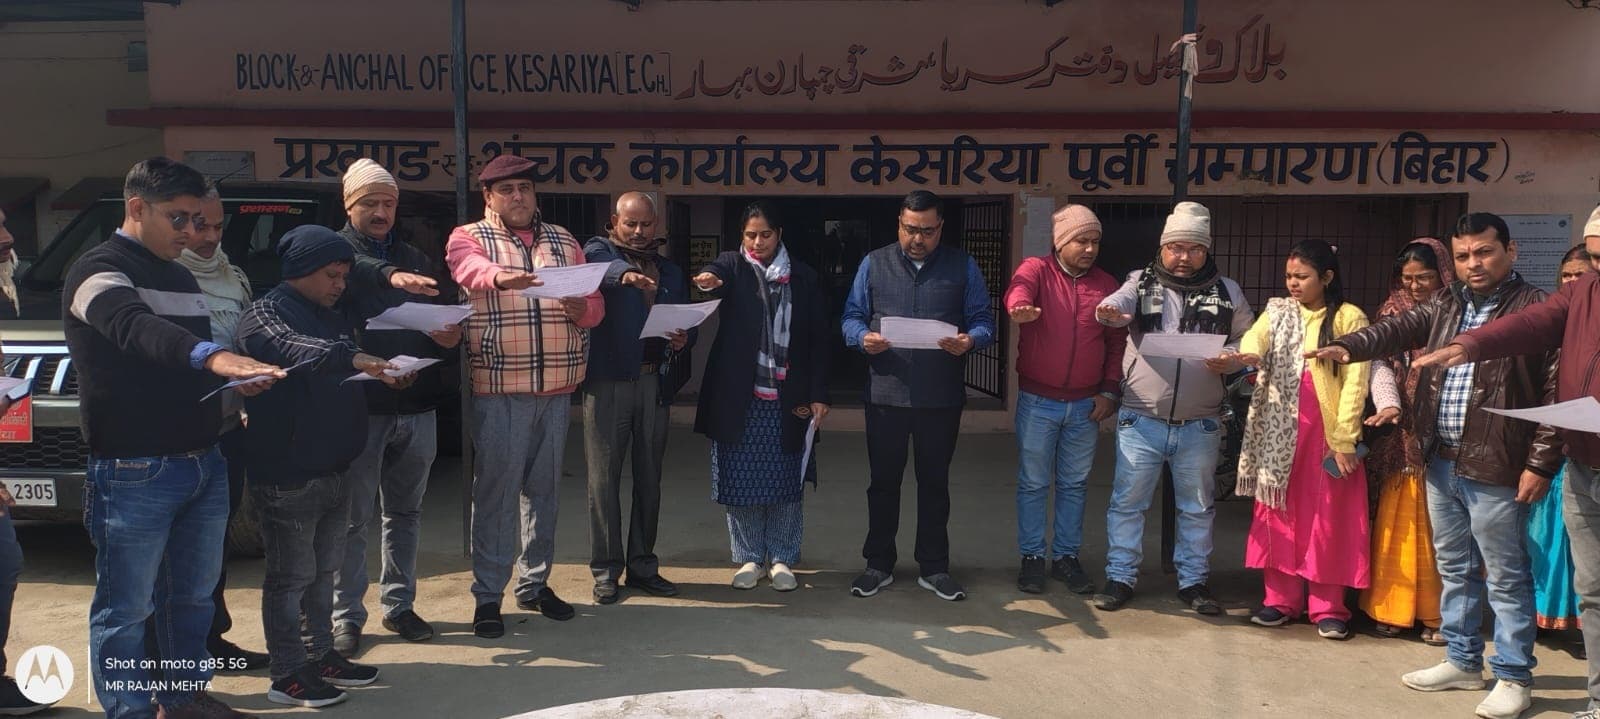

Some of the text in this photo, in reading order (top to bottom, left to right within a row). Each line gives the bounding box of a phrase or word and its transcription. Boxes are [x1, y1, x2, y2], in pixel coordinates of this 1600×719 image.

[630, 135, 839, 187] कार्यालय
[850, 135, 1050, 187] केसरिया
[1063, 133, 1160, 192] पूर्वी
[13, 483, 54, 500] 2305
